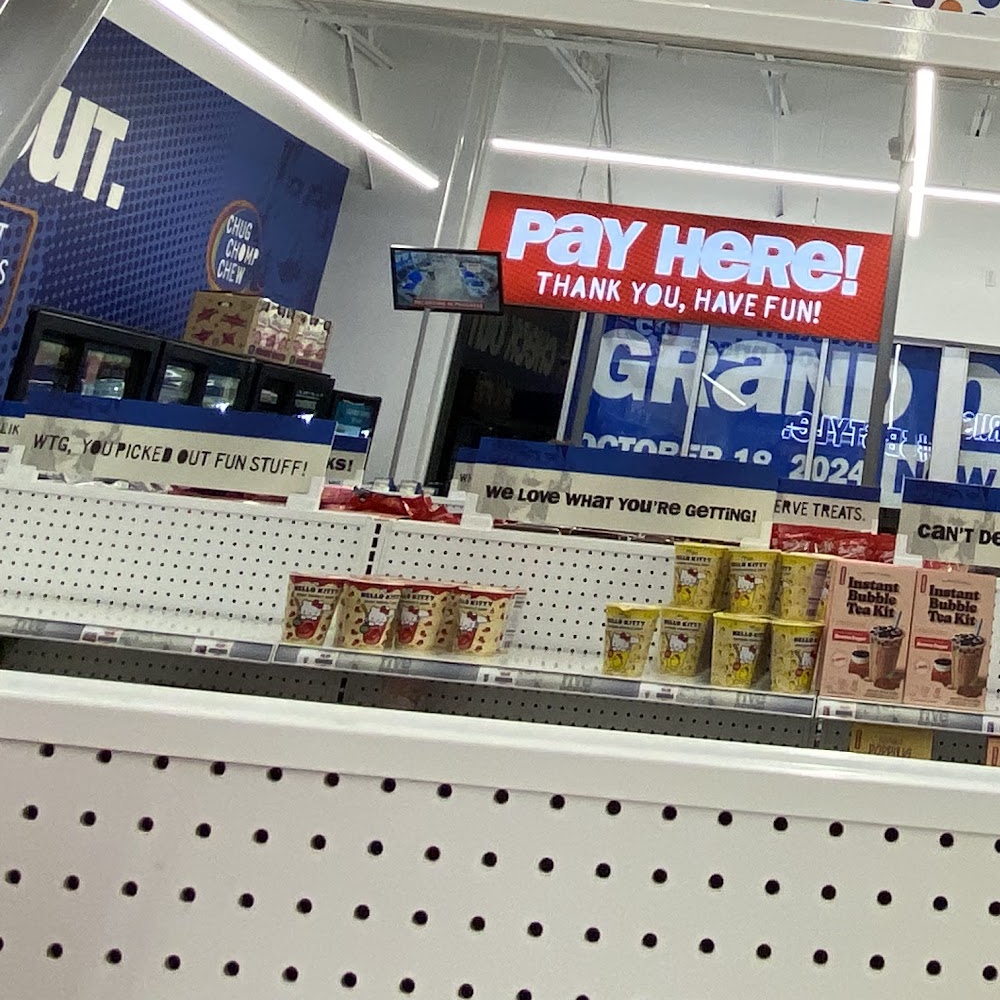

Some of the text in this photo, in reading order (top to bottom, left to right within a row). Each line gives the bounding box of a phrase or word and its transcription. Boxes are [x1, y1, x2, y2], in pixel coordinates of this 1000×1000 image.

[20, 84, 130, 211] UT.
[226, 214, 253, 241] CHUG
[225, 238, 260, 266] CHOMP
[217, 259, 246, 285] CHEW
[536, 271, 822, 324] THANK YOU, HAVE FUN!
[34, 434, 308, 477] WTG, YOU PICKED OUT FUN STUFF!
[789, 454, 864, 486] 2024
[893, 459, 997, 493] NW
[813, 502, 866, 521] TREATS.
[848, 577, 899, 592] Instant
[848, 590, 897, 605] Bubble
[929, 585, 980, 600] Instant
[848, 603, 895, 618] Tea Kit
[928, 610, 976, 626] Tea Kit
[929, 598, 977, 613] Bubble
